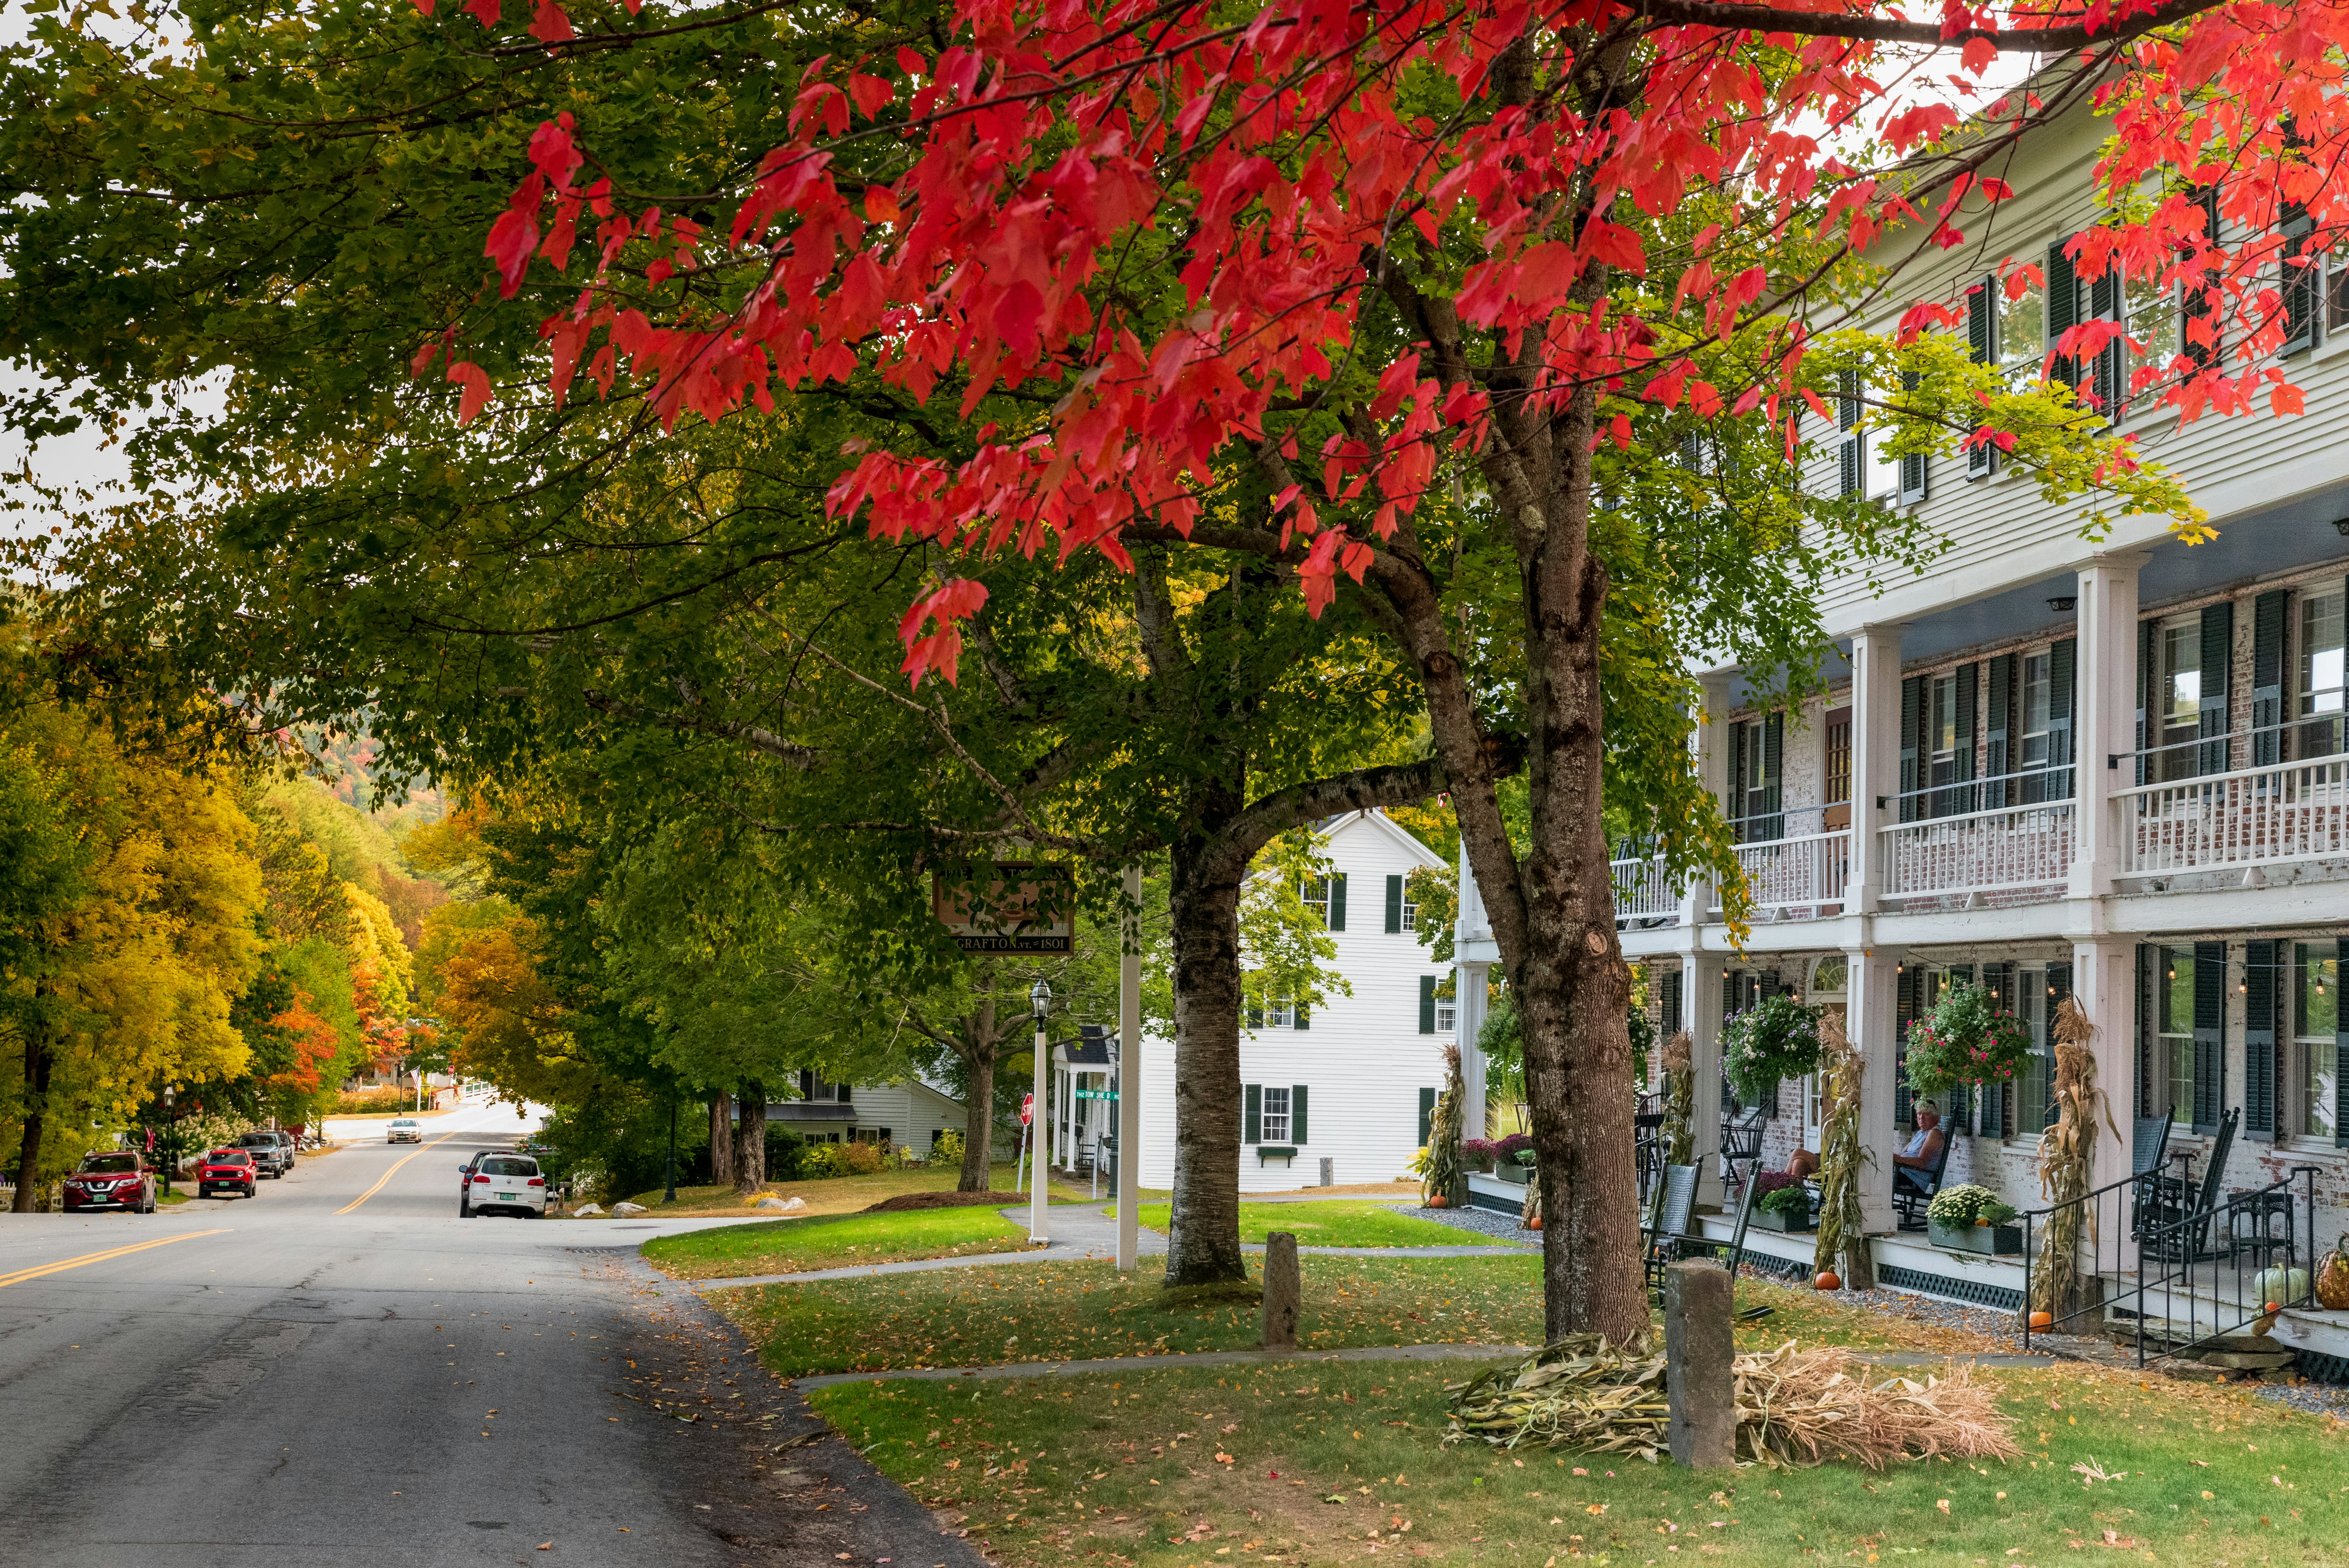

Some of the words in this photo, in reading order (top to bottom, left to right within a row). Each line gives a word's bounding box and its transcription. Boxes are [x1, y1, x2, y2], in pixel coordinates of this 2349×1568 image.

[1009, 869, 1064, 878] TAN
[1041, 939, 1064, 949] 1801
[1022, 1103, 1033, 1116] STOP
